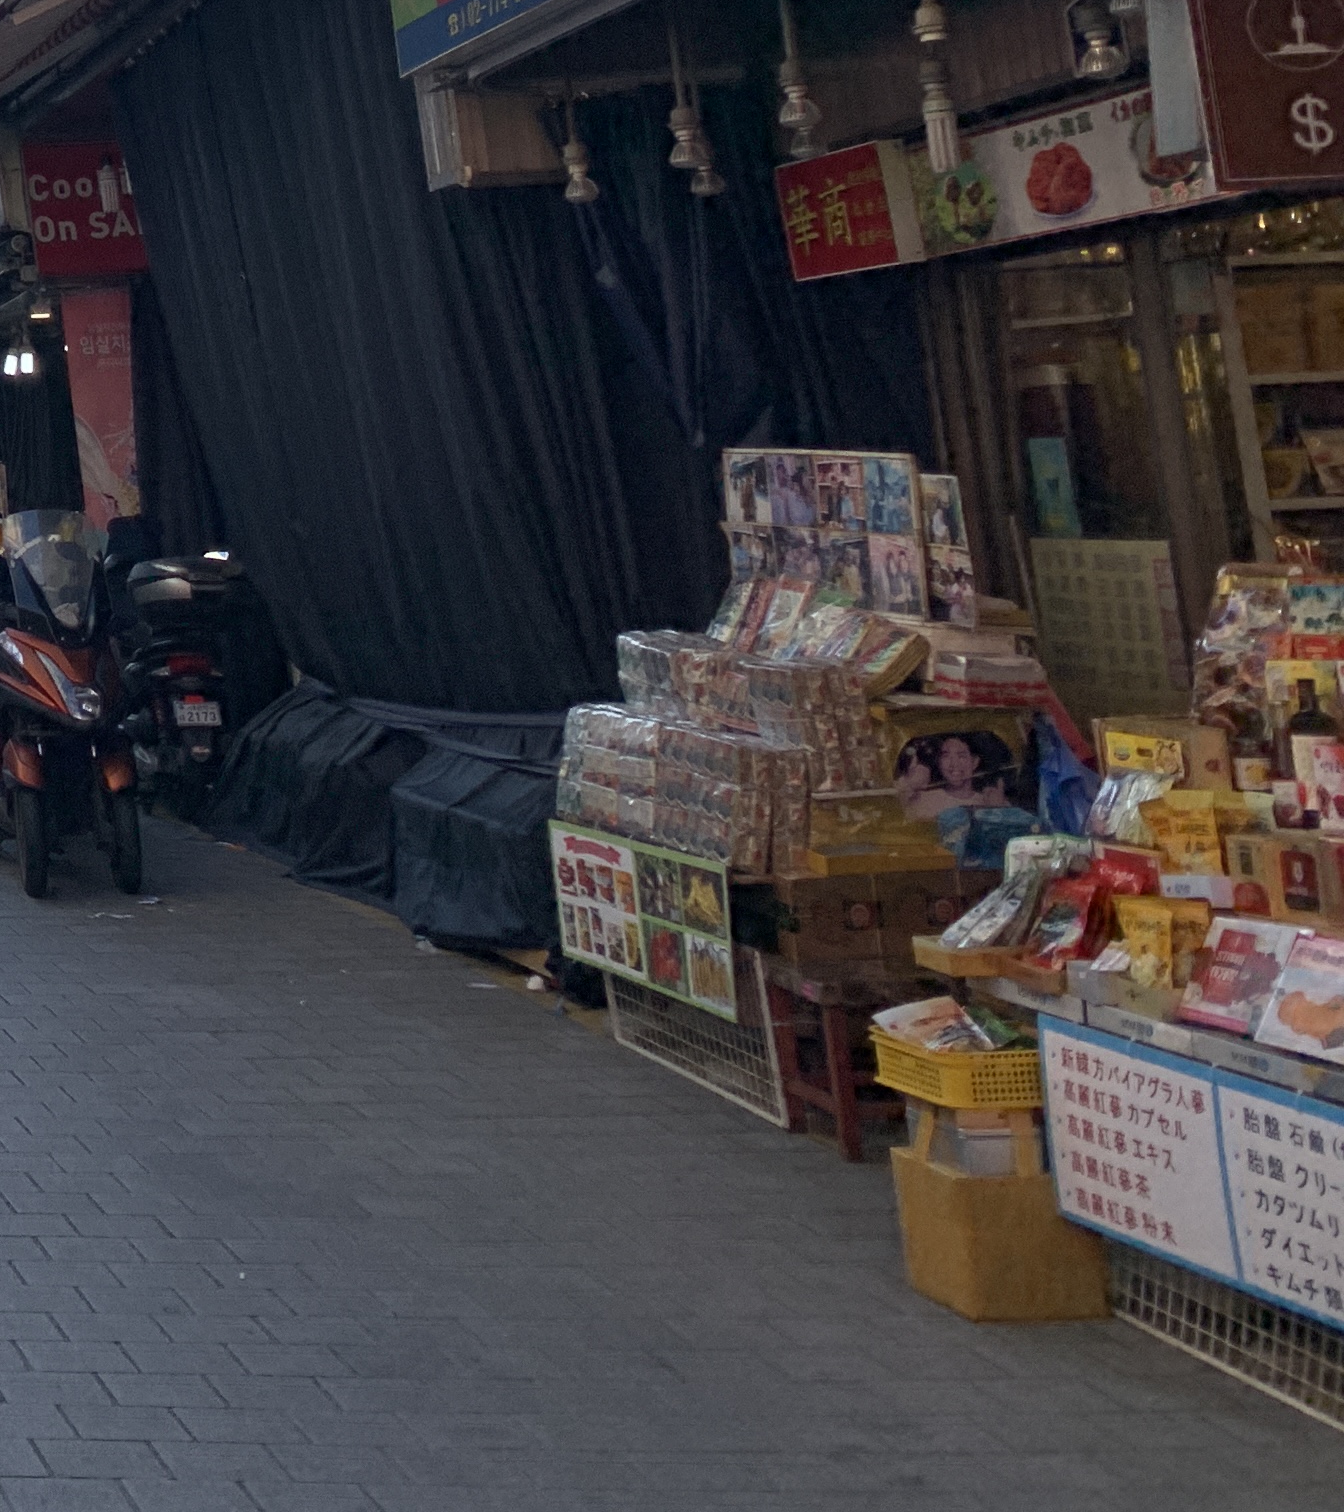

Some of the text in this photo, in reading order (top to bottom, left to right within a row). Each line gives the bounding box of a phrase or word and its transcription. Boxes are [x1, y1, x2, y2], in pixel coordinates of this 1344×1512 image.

[34, 210, 143, 243] On SA
[188, 712, 217, 722] 2173
